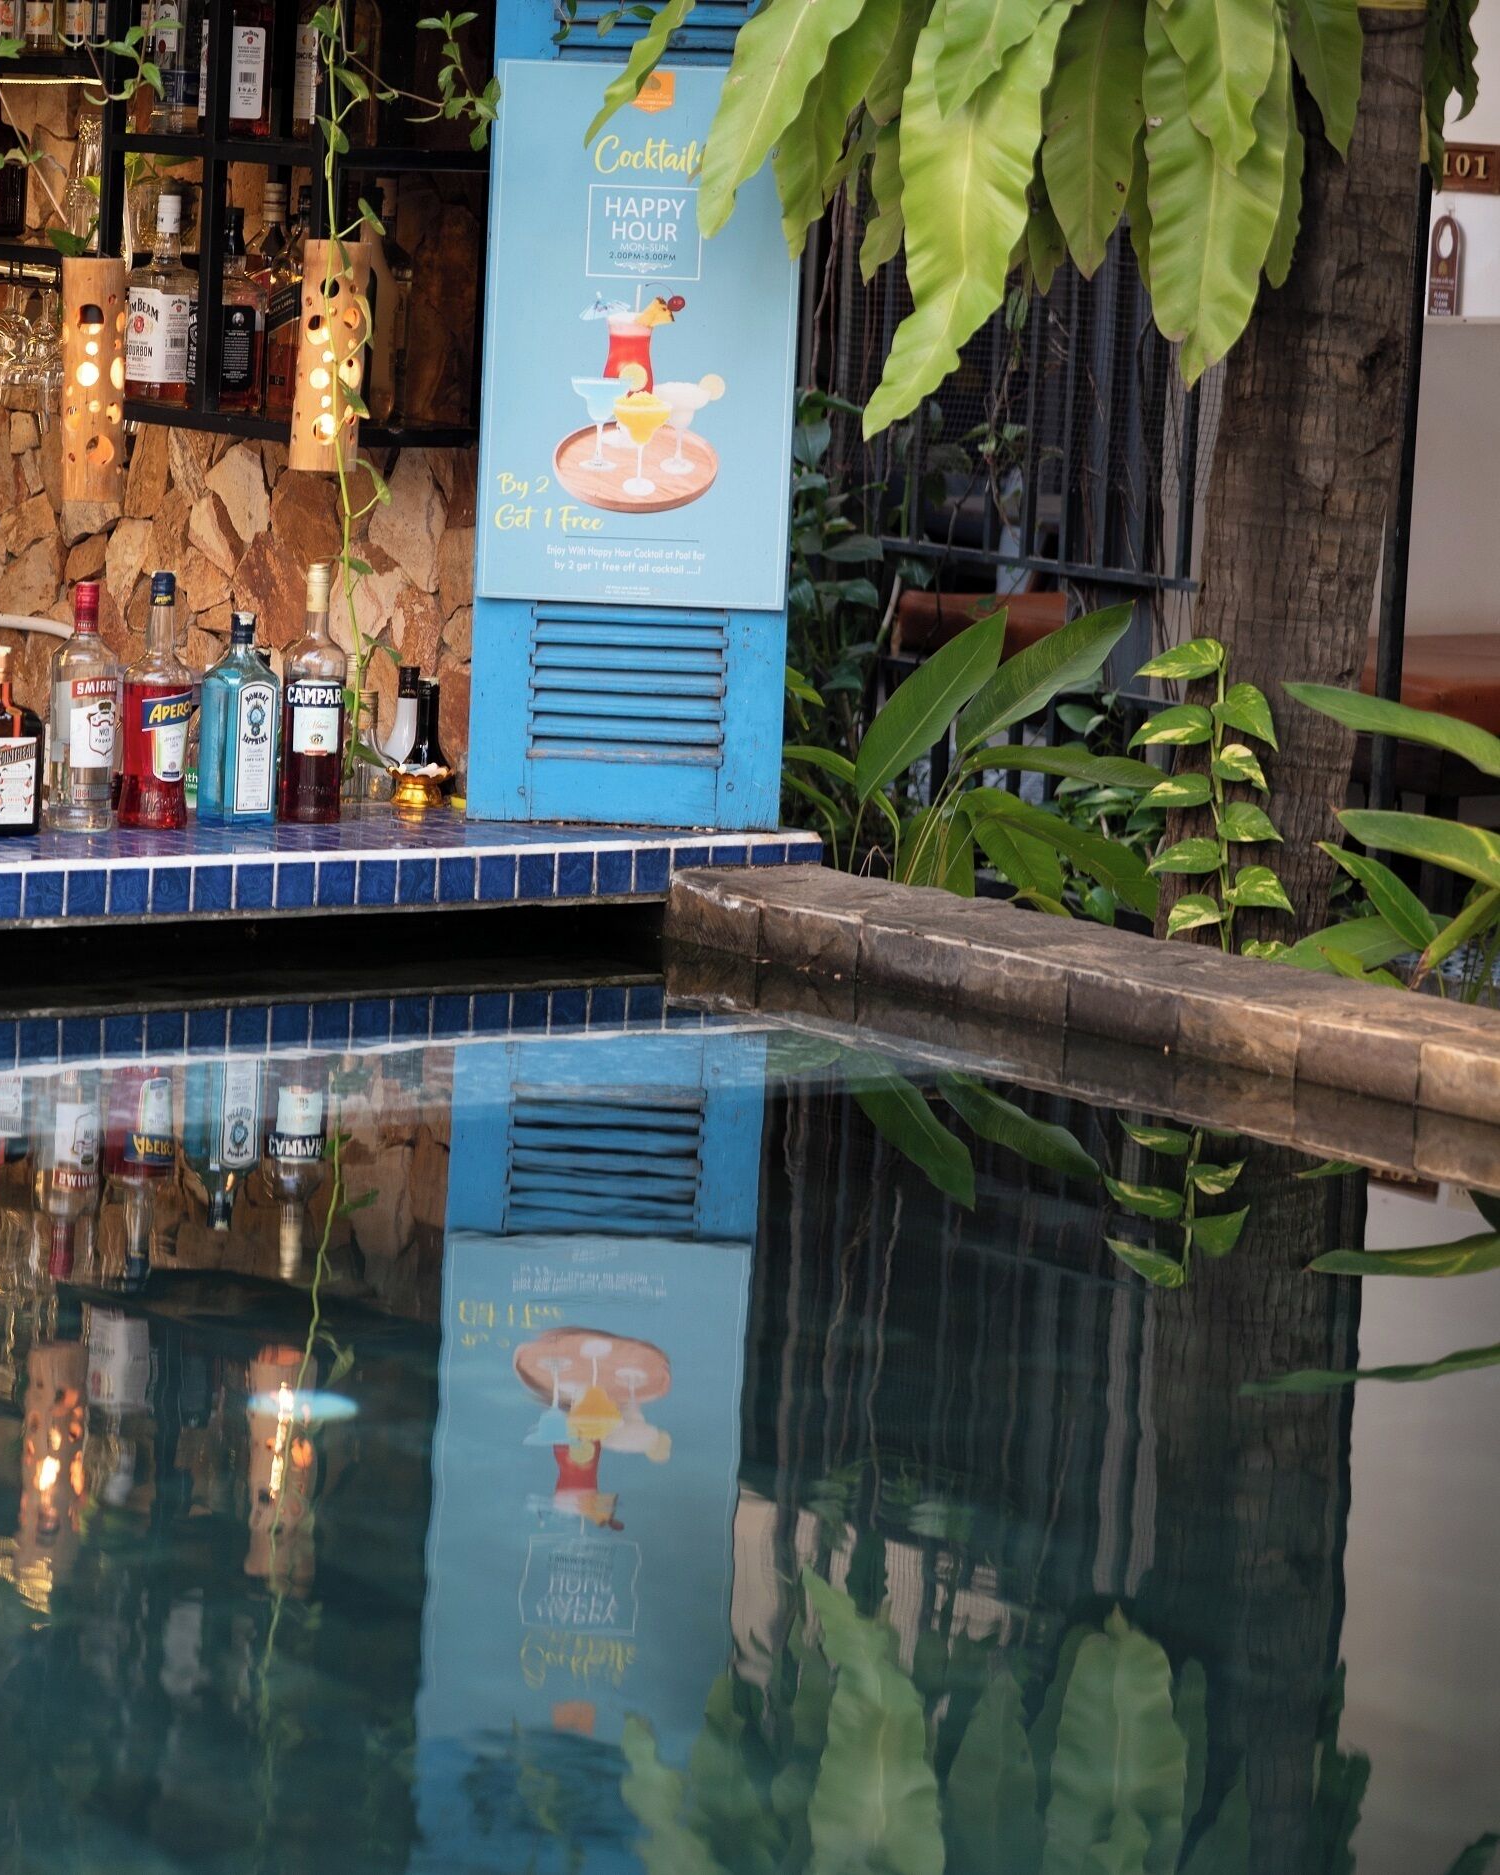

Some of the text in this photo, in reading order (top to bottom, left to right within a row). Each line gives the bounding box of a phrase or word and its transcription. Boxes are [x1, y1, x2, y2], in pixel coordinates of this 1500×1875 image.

[605, 196, 686, 220] HAPPY
[611, 220, 677, 242] HOUR
[619, 242, 669, 252] MON-SUN
[137, 298, 160, 322] BEAM
[496, 472, 549, 499] By 2
[494, 503, 604, 532] Get 1 Free
[546, 544, 705, 561] Enjoy With Happy Hour Cocktail at Pool Bar
[554, 559, 565, 571] by
[568, 560, 575, 570] 2
[577, 563, 591, 573] get
[602, 562, 620, 572] free
[622, 562, 636, 573] off
[638, 563, 649, 573] all
[651, 564, 684, 574] cocktail
[245, 691, 269, 704] BOMBAY
